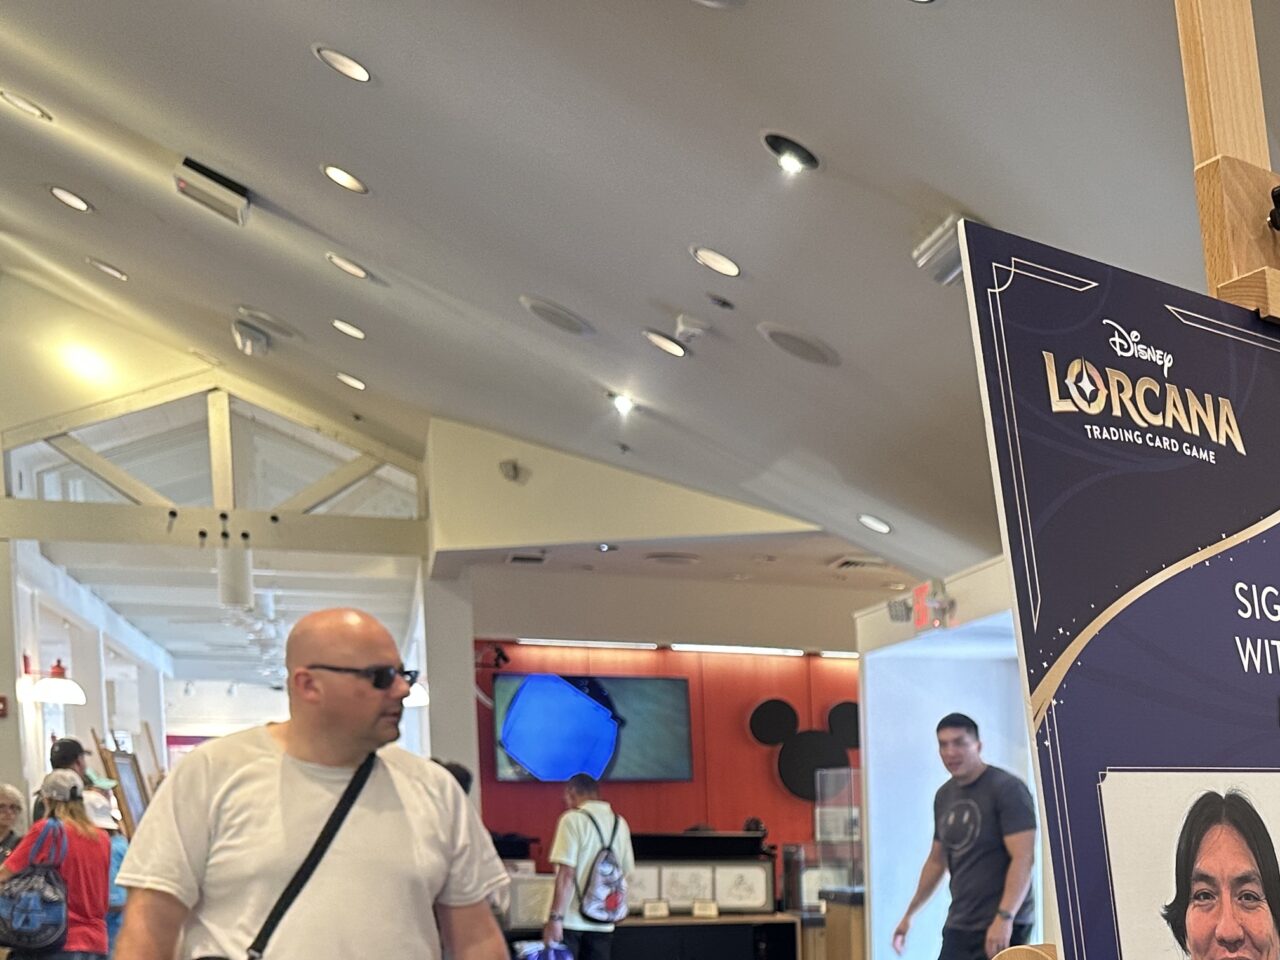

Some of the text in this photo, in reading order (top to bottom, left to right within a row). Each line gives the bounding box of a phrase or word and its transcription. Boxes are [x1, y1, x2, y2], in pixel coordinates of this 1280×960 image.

[1102, 319, 1173, 378] Disney
[1042, 350, 1247, 456] LORCANA
[1084, 425, 1216, 464] TRADING CARD GAME
